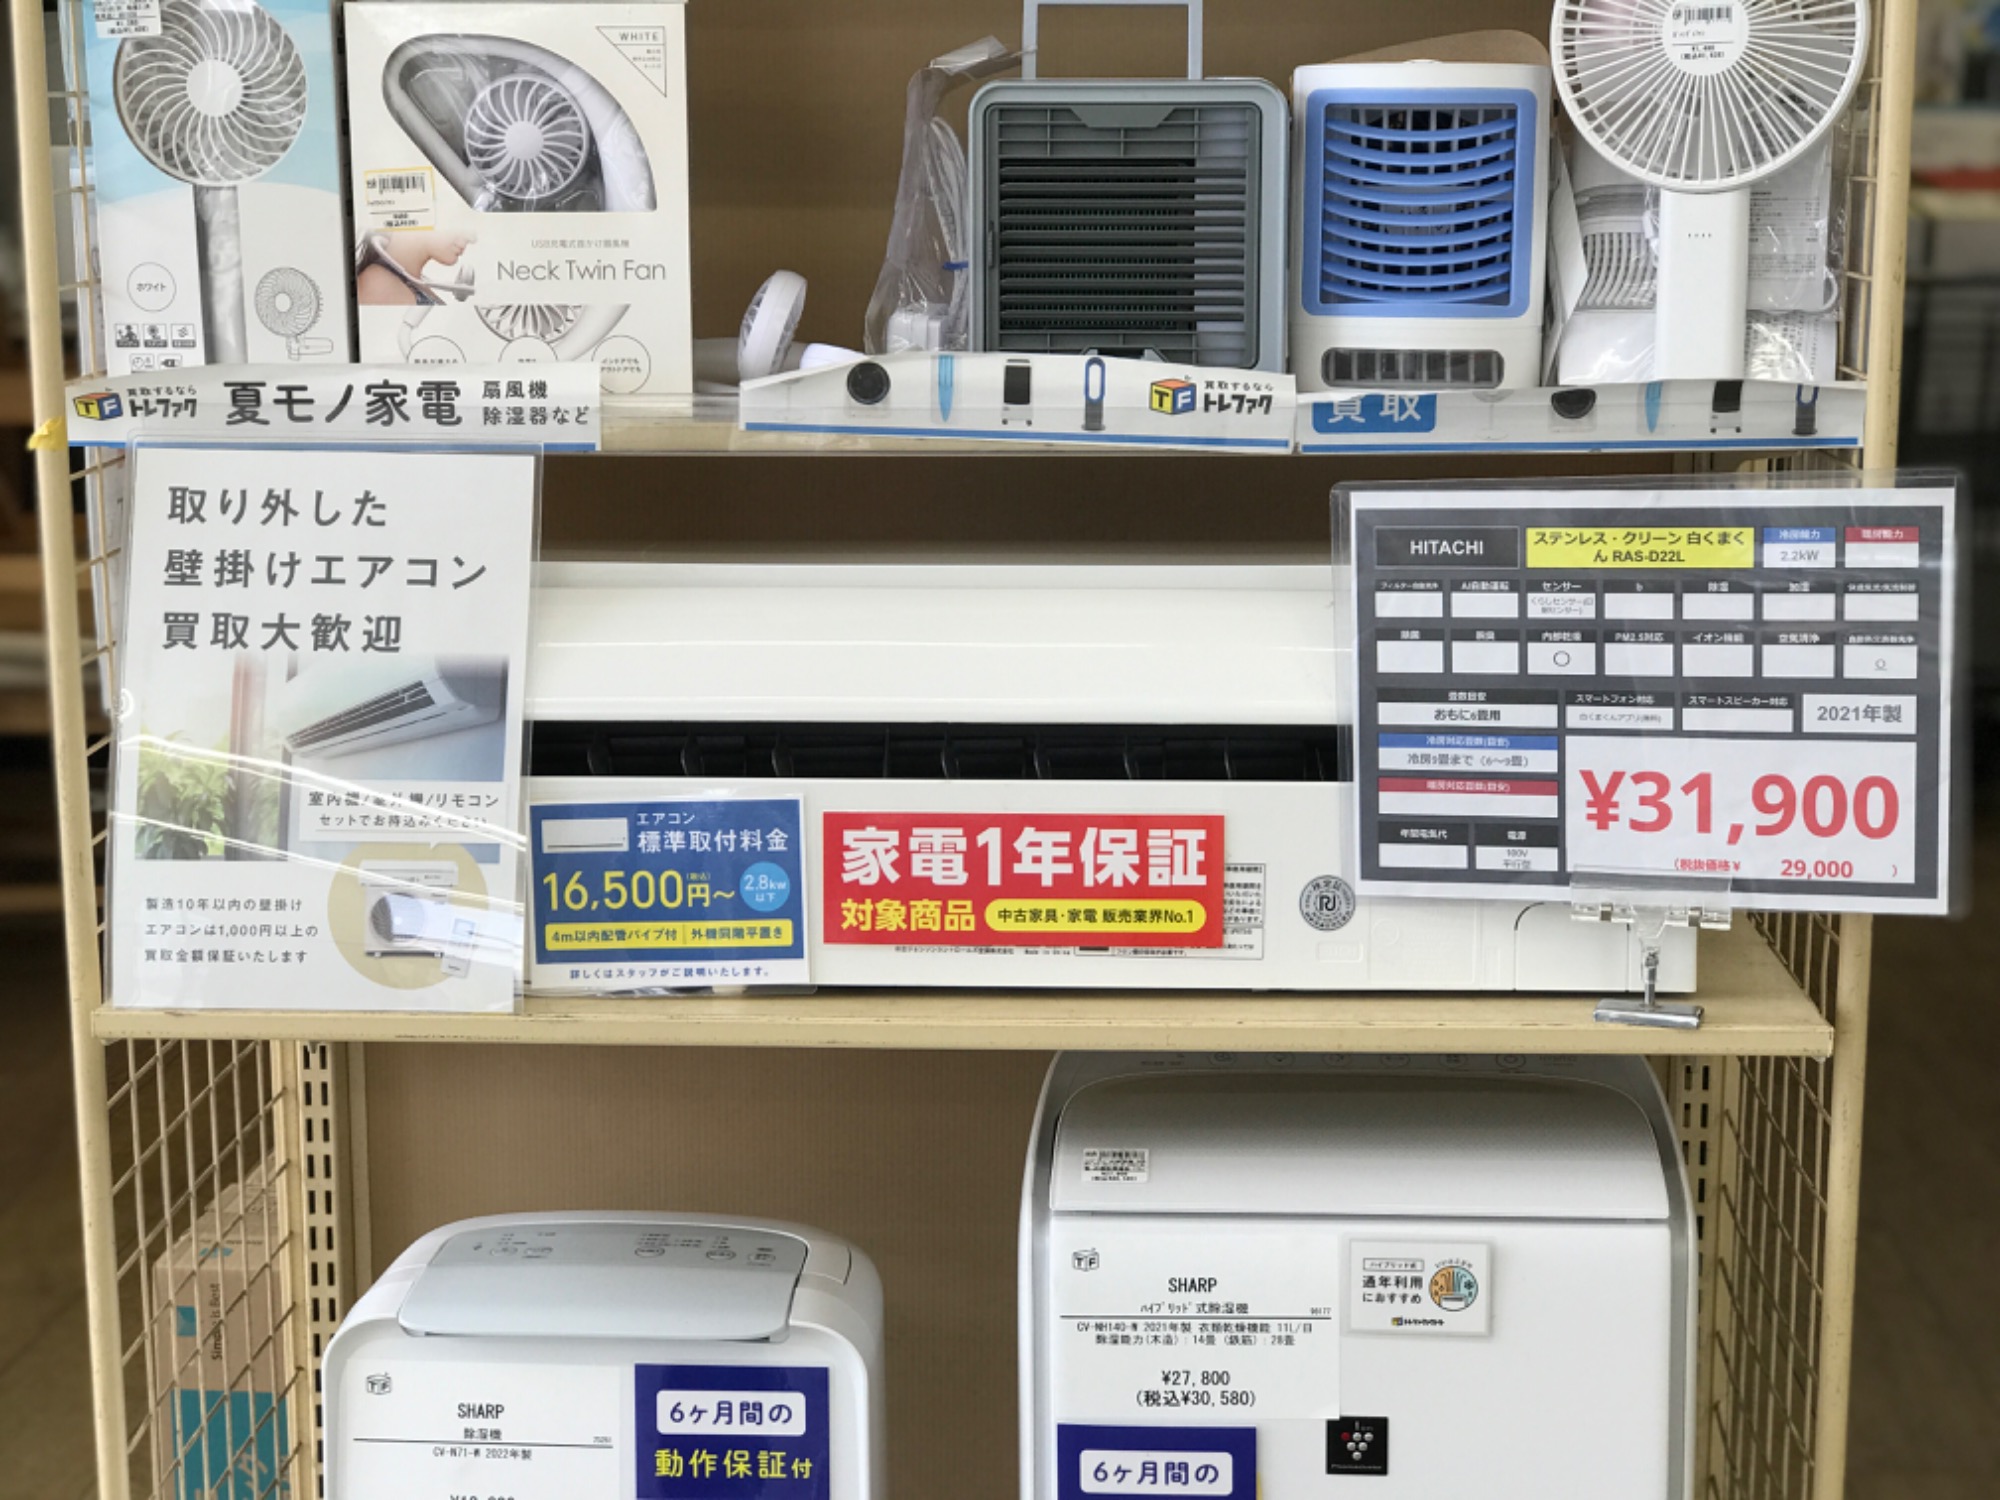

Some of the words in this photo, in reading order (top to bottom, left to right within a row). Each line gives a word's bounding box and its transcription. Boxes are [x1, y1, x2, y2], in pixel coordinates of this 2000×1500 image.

[619, 32, 659, 41] WHITE
[497, 259, 560, 281] Neck
[565, 259, 616, 281] Twin
[624, 259, 666, 281] Fan
[136, 282, 167, 292] ホワイト
[126, 385, 198, 397] 買取するなら
[482, 380, 548, 399] 扇風機
[1204, 380, 1275, 391] 買取するなら
[128, 398, 198, 418] トレファク
[223, 379, 463, 427] 夏モノ家電
[1203, 393, 1273, 414] トレファク
[482, 406, 590, 426] 除湿器など
[168, 486, 387, 526] 取り外した
[1534, 530, 1682, 546] ステンレス・クリーン
[1686, 530, 1745, 546] 白くまく
[1409, 540, 1484, 555] HITACHI
[1593, 549, 1608, 563] ん
[1613, 549, 1685, 563] RAS-D22L
[1780, 550, 1820, 561] 2.2kW
[164, 549, 487, 590] 壁掛けエアコン
[1541, 581, 1582, 591] センサー
[163, 611, 402, 653] 買取大歓迎
[1778, 633, 1820, 644] 空気清浄
[1575, 694, 1654, 705] スマートフォン対応
[1688, 696, 1788, 706] スマートスピーカー対応
[1433, 709, 1501, 722] おもに6畳用
[1816, 704, 1902, 723] 2021年製
[1579, 768, 1900, 845] ¥31,900
[636, 813, 696, 826] エアコン
[637, 828, 789, 853] 標準取付料金
[841, 826, 1208, 887] 家電1年保証
[1780, 859, 1854, 880] 29,000
[145, 898, 302, 911] 製造10年以内の壁掛け
[755, 892, 776, 903] 以下
[841, 898, 976, 932] 対象商品
[1102, 908, 1194, 924] 販売業界No.1
[145, 924, 319, 938] エアコンは1,000円以上の
[551, 929, 678, 943] 4m以内配管パイプ付
[691, 926, 783, 940] 外機同階平置き
[145, 949, 308, 964] 買取金額保証いたします
[570, 967, 769, 981] 詳しくはスタッフがご説明いたします。
[1168, 1278, 1217, 1293] SHARP
[1363, 1275, 1423, 1289] 通年利用
[1363, 1293, 1422, 1304] におすすめ
[1144, 1323, 1192, 1333] 2021年製
[1199, 1323, 1271, 1333] 衣類乾燥機能
[1162, 1370, 1231, 1388] ¥27,800
[1136, 1390, 1257, 1408] (税込¥30,580)
[457, 1403, 505, 1419] SHARP
[670, 1400, 793, 1425] 6ヶ月間の
[463, 1427, 503, 1441] 除湿機
[486, 1448, 532, 1460] 2022年製
[654, 1448, 813, 1479] 動作保証付
[1093, 1461, 1220, 1486] 6ヶ月間の
